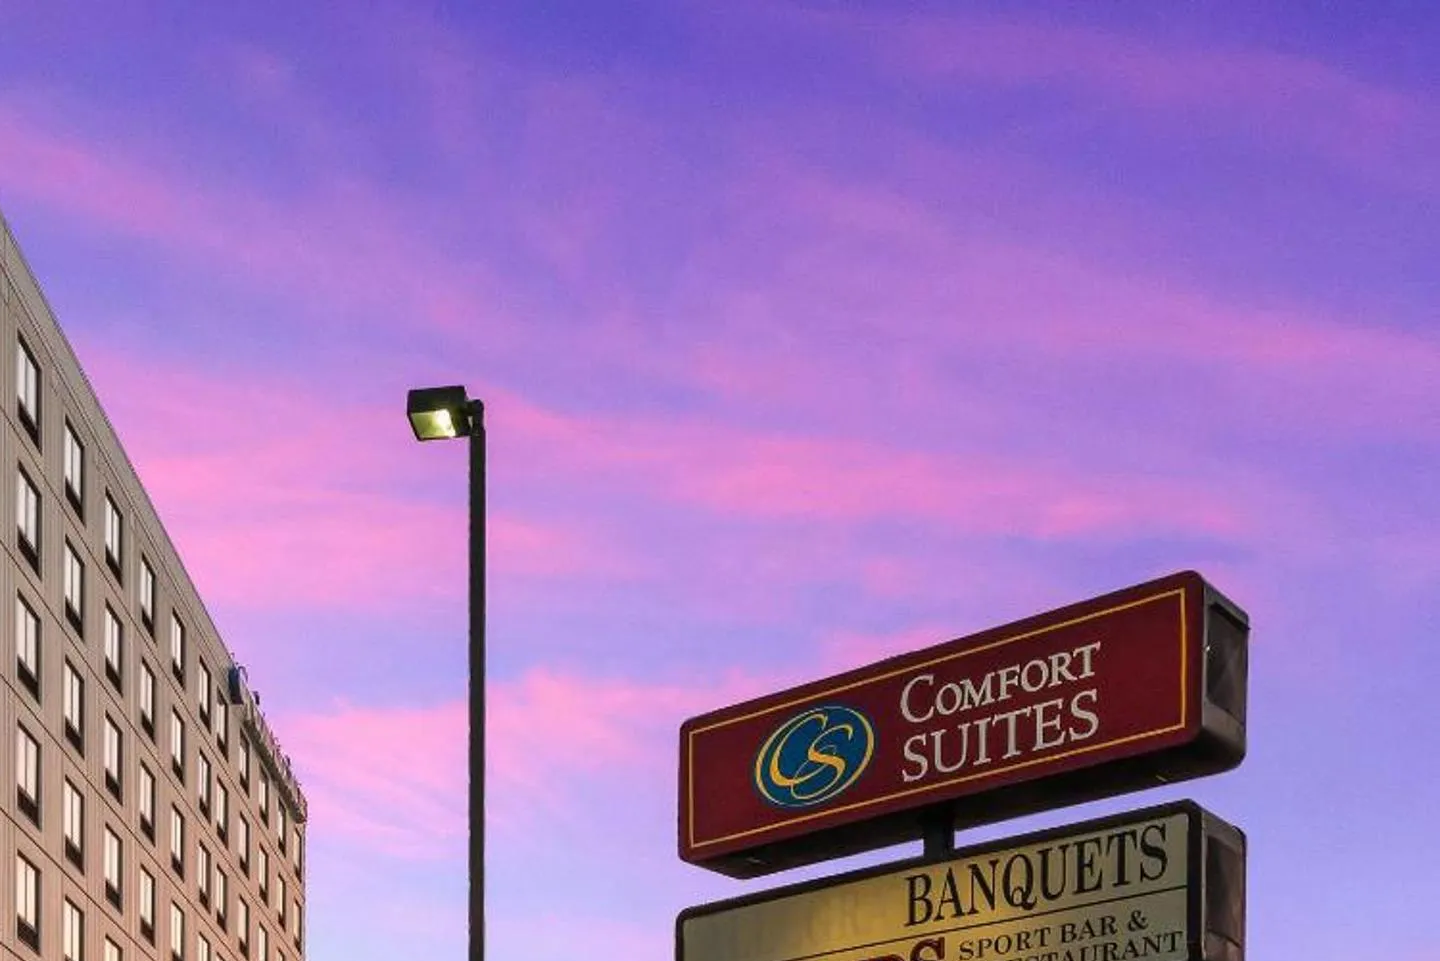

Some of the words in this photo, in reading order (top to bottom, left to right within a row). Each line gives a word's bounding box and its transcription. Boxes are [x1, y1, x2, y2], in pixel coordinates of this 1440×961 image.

[899, 641, 1101, 723] COMFORT
[901, 688, 1100, 782] SUITES
[904, 823, 1168, 927] BANQUETS
[959, 926, 1051, 961] SPORT
[1061, 915, 1118, 944] BAR
[1127, 910, 1148, 932] &
